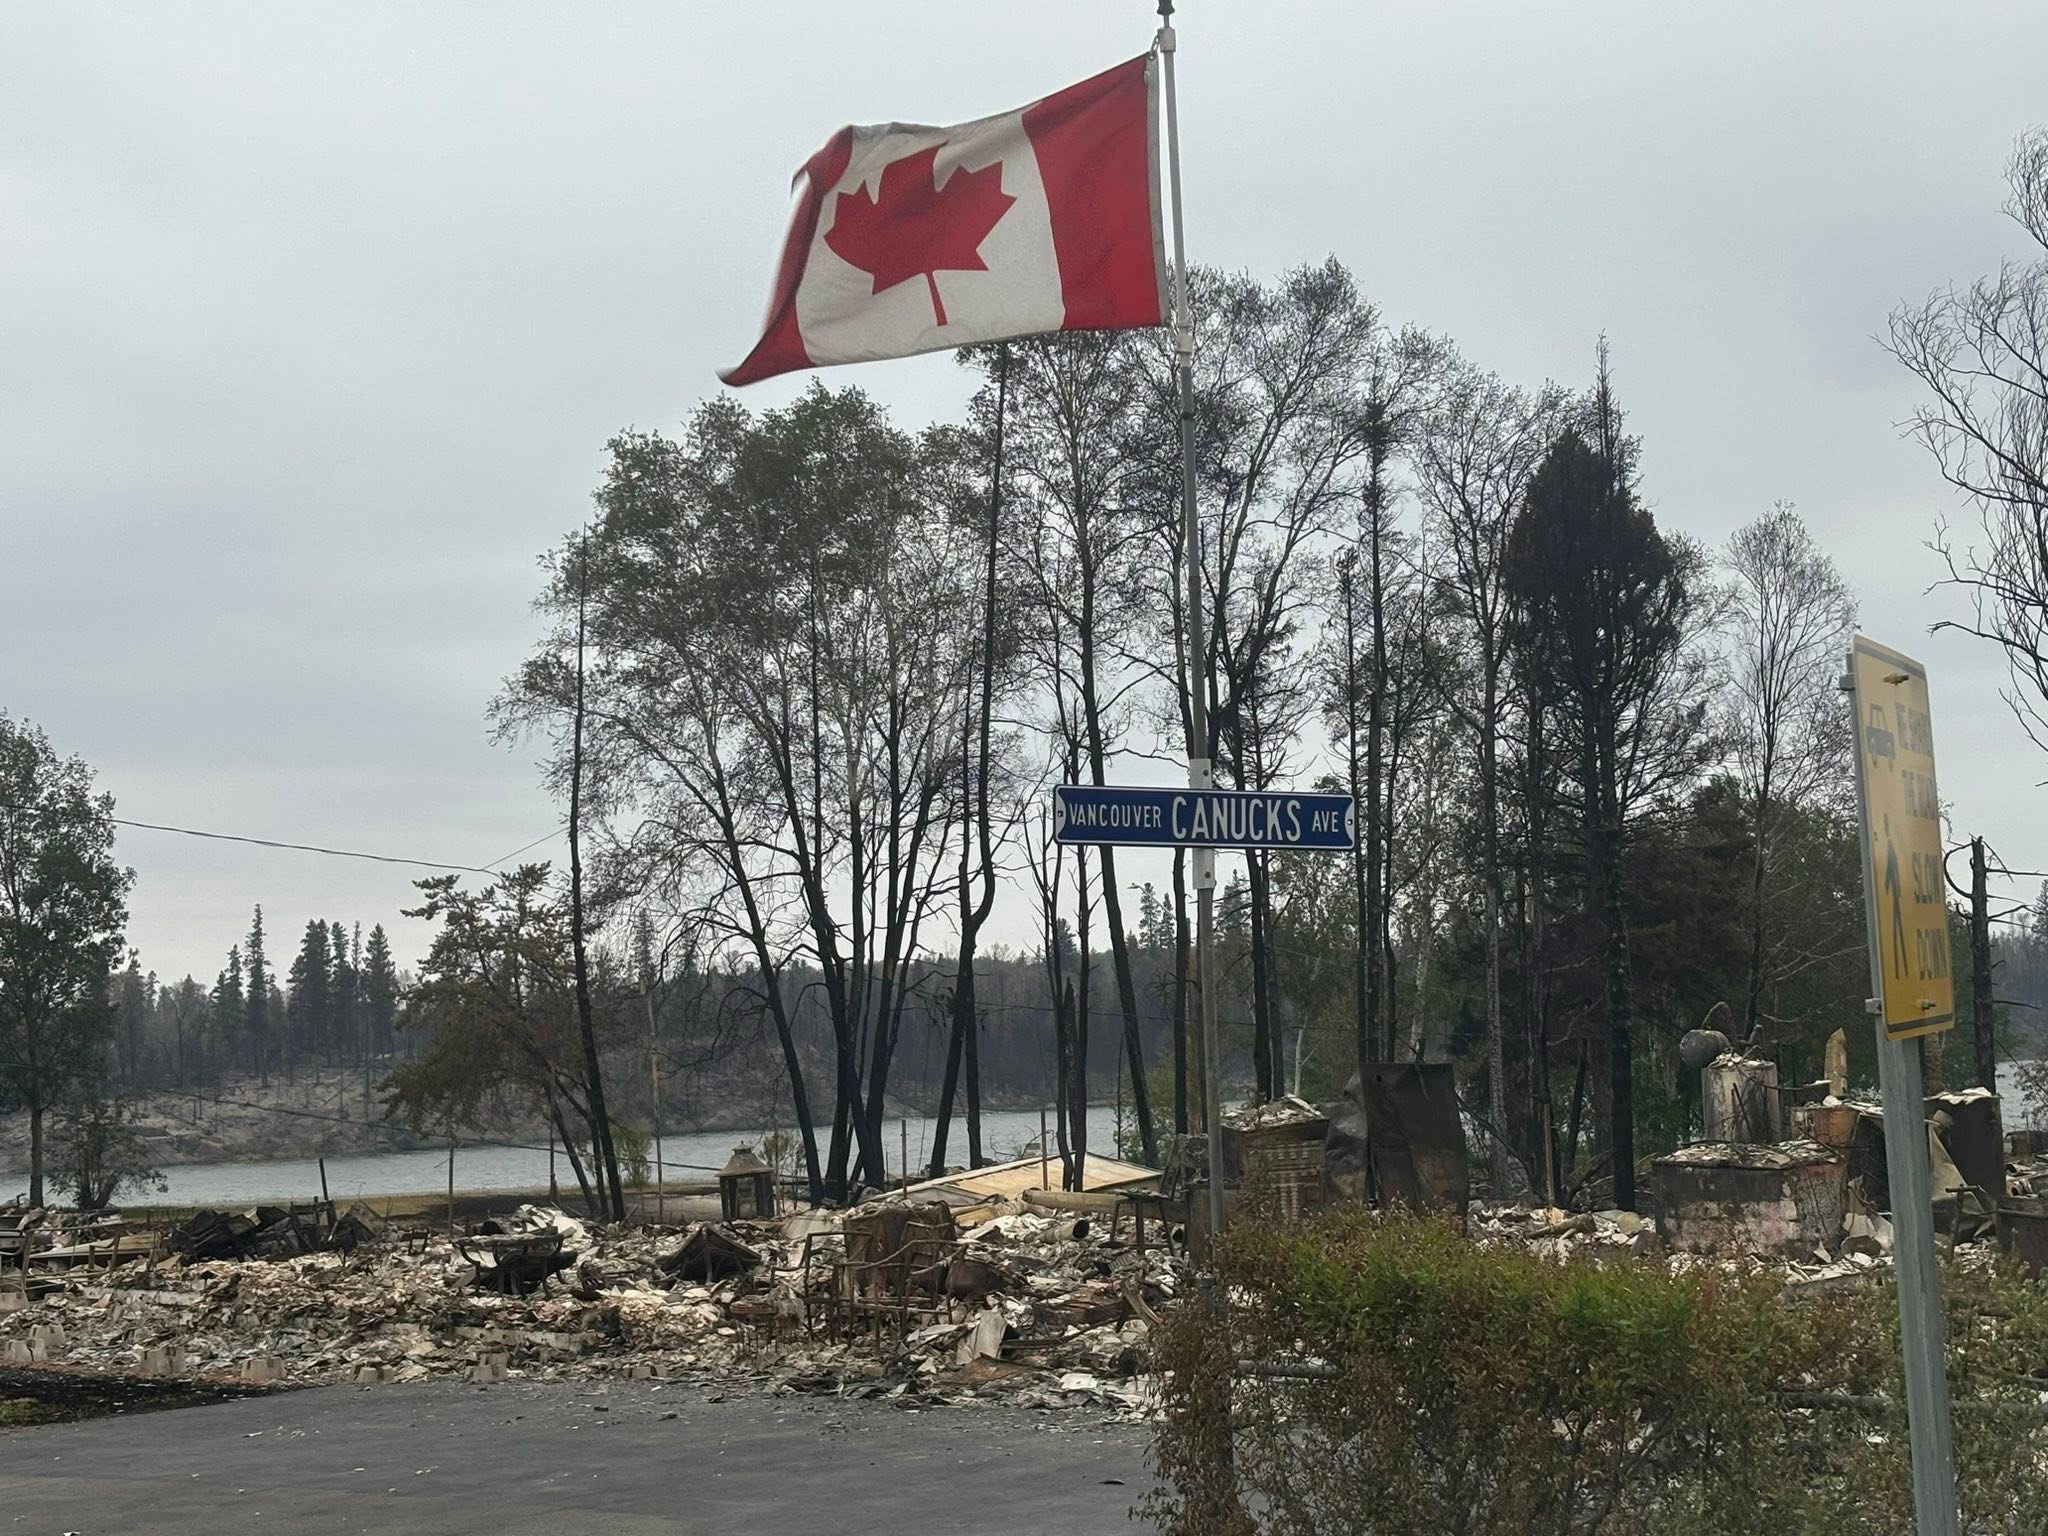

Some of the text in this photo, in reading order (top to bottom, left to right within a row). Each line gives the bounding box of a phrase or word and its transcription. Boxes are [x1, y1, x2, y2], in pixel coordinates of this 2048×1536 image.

[1069, 796, 1339, 842] VANCOUVER CANUCKS AVE
[1912, 851, 1941, 904] SLOW
[1917, 928, 1947, 980] DOWN
